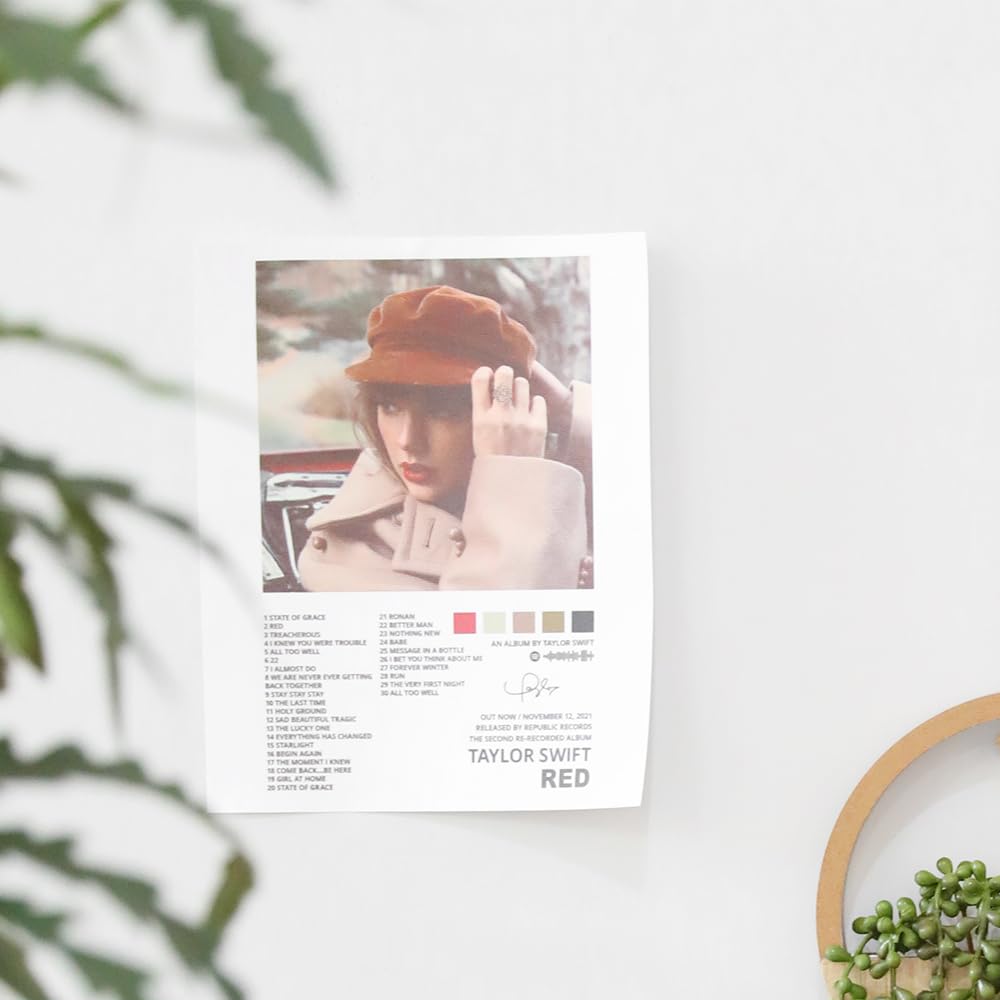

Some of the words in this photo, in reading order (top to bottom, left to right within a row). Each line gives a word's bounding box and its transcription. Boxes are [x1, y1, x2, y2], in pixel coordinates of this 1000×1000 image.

[468, 748, 534, 763] TAYLOR
[539, 748, 591, 762] SWIFT
[541, 768, 590, 788] RED
